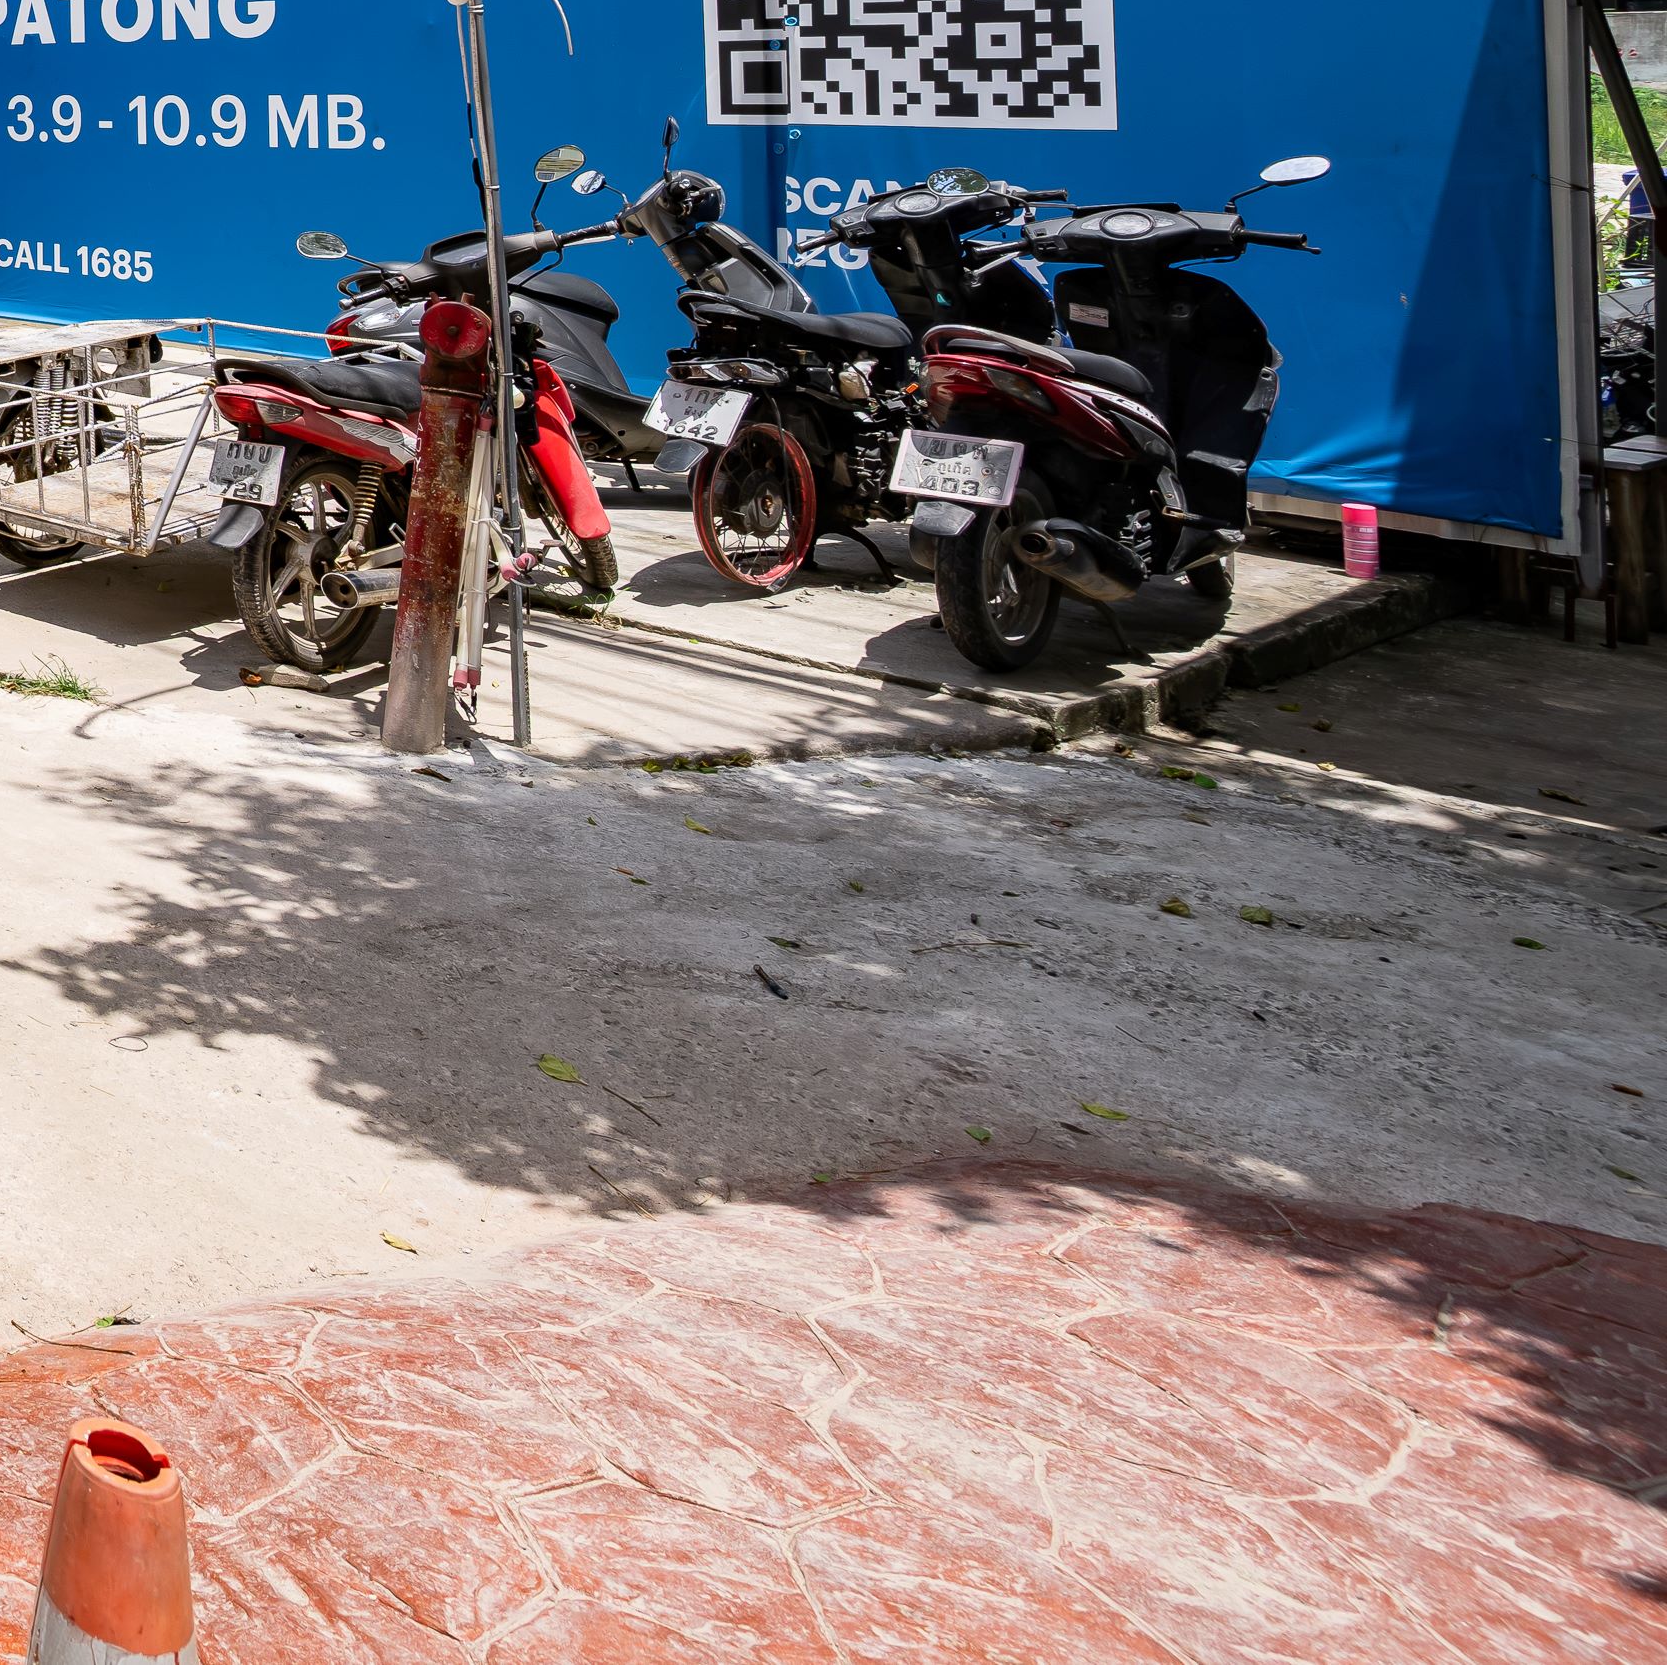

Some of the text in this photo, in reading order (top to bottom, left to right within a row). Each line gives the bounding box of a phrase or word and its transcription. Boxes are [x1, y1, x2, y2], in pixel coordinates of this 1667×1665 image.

[7, 95, 82, 143] 3.9
[129, 93, 246, 148] 10.9
[268, 93, 385, 150] MB.
[76, 244, 154, 283] 1685
